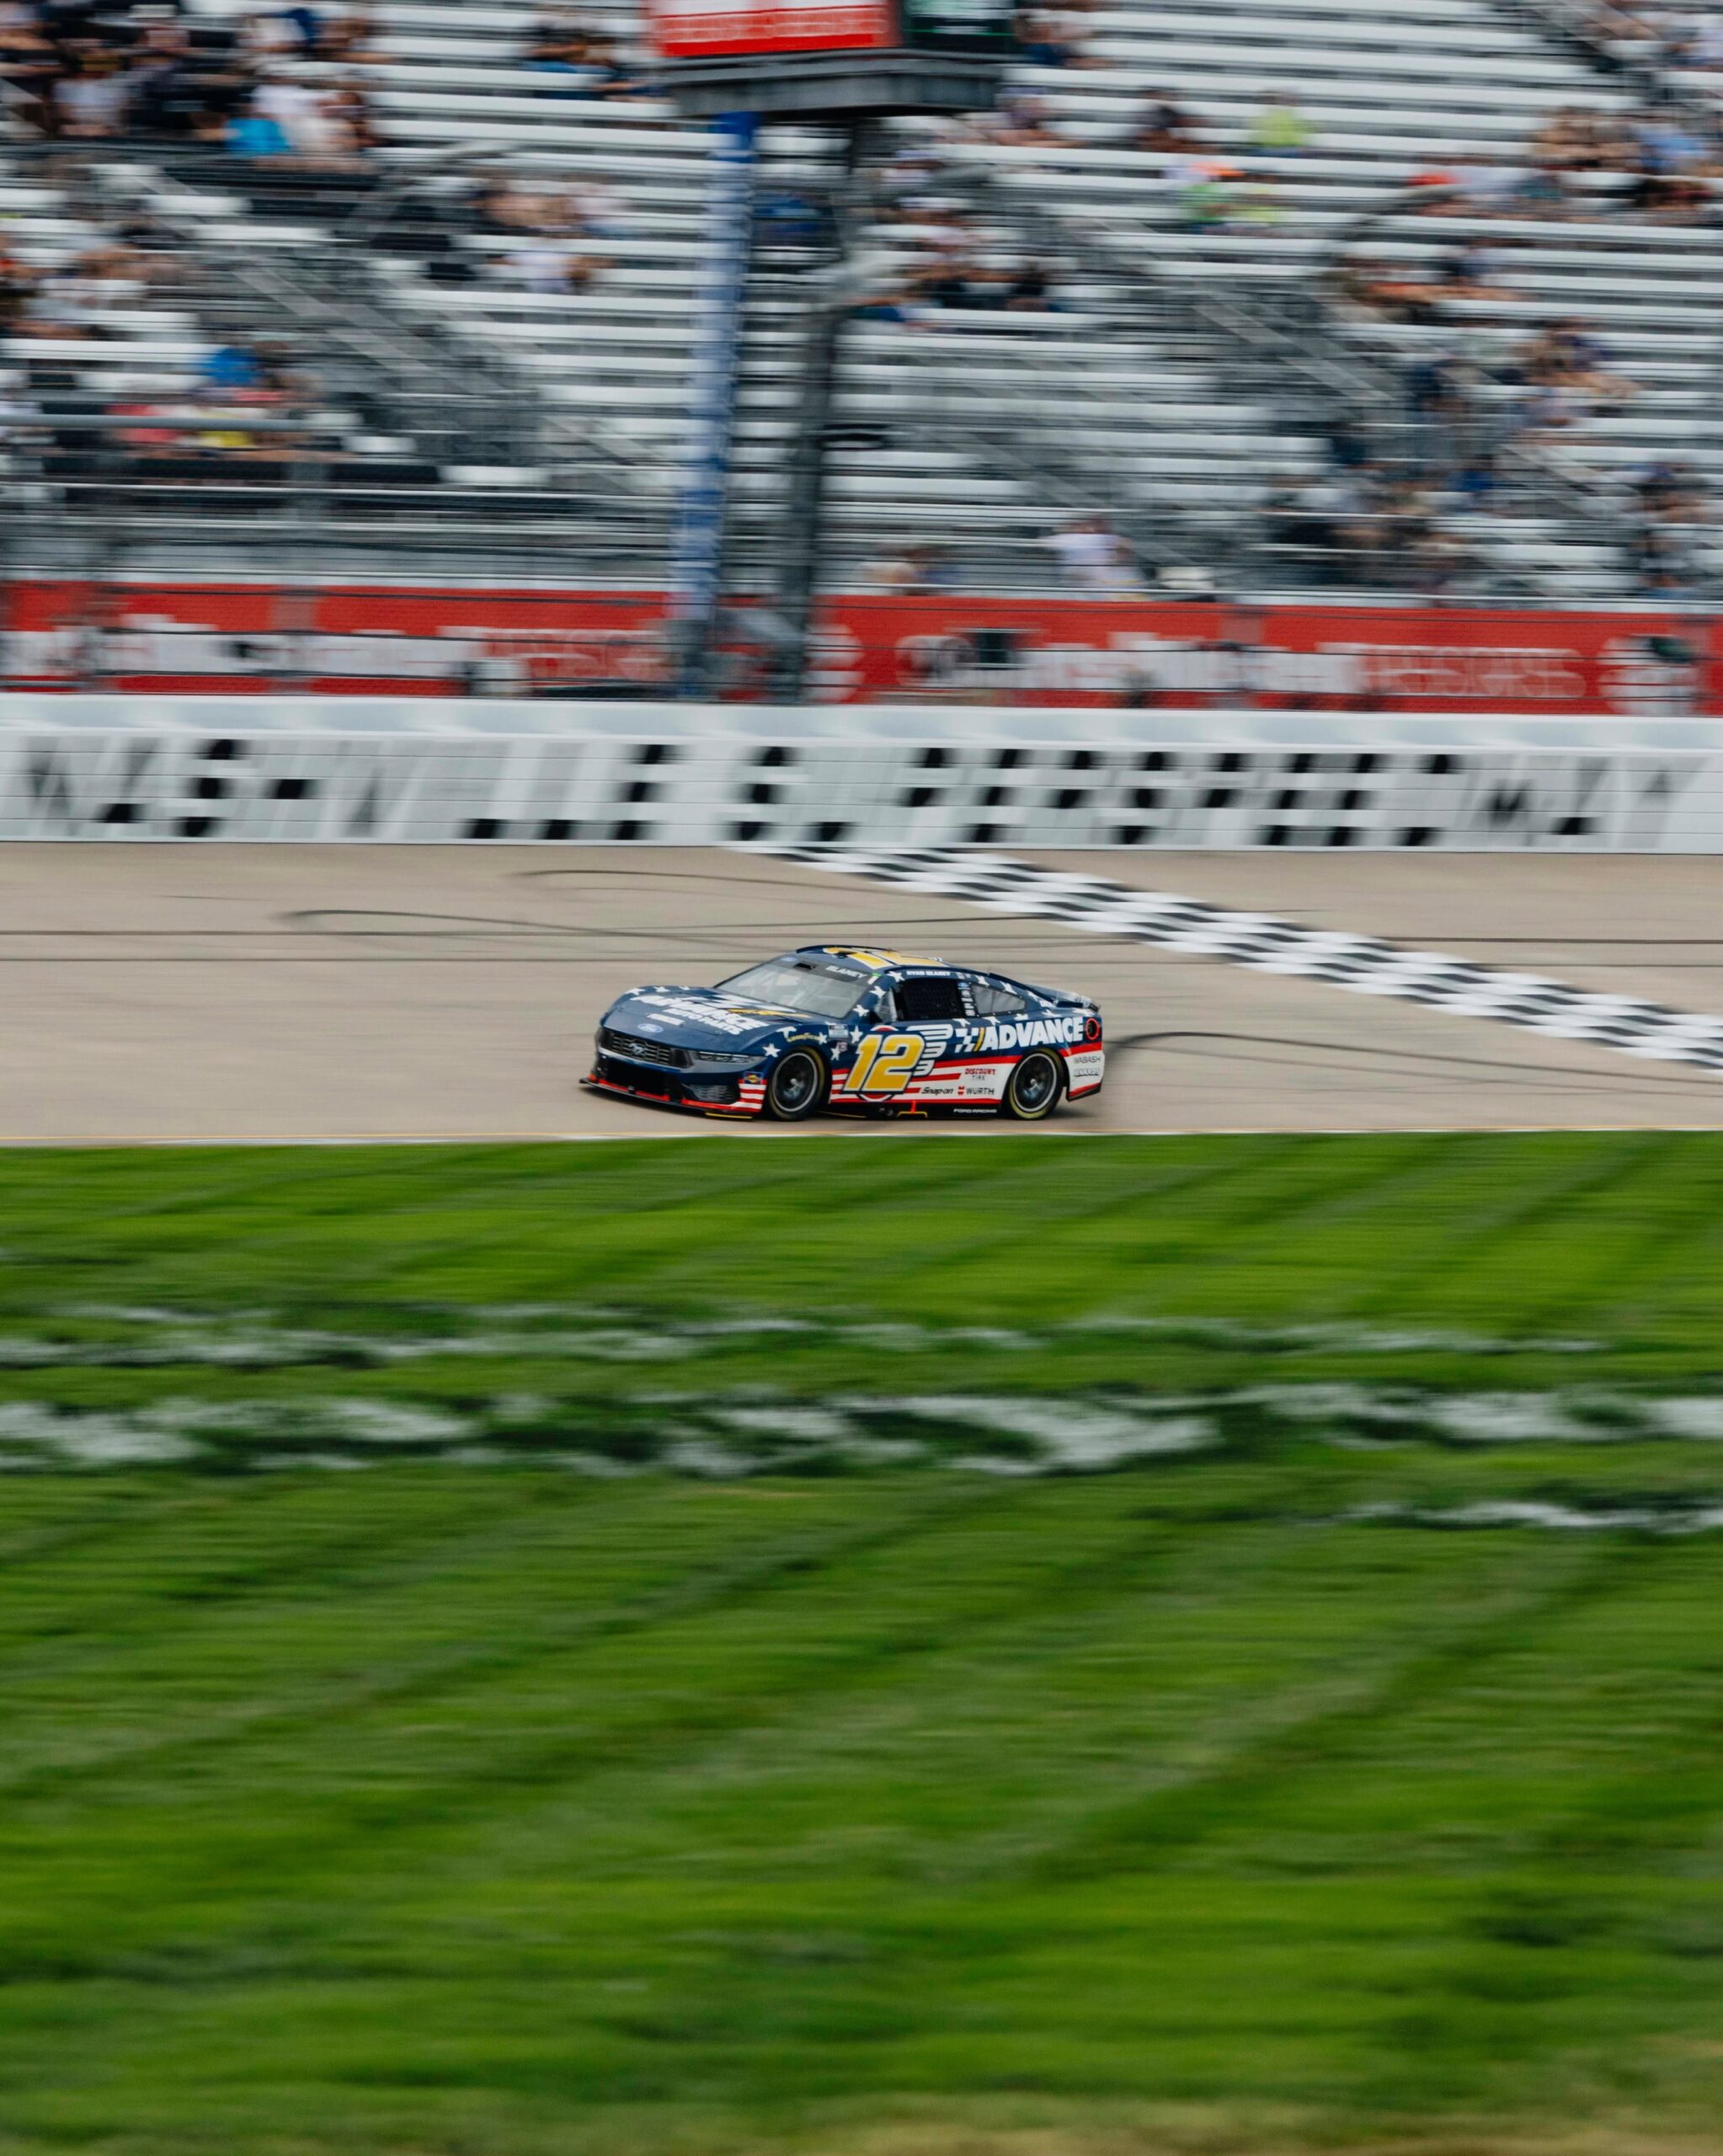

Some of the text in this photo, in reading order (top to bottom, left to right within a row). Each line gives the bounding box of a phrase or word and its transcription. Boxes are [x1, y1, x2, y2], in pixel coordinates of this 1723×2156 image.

[825, 965, 867, 978] BLANEY
[979, 1017, 1083, 1050] ADVANCE
[842, 1033, 926, 1091] 12
[921, 1086, 953, 1096] Snap-on
